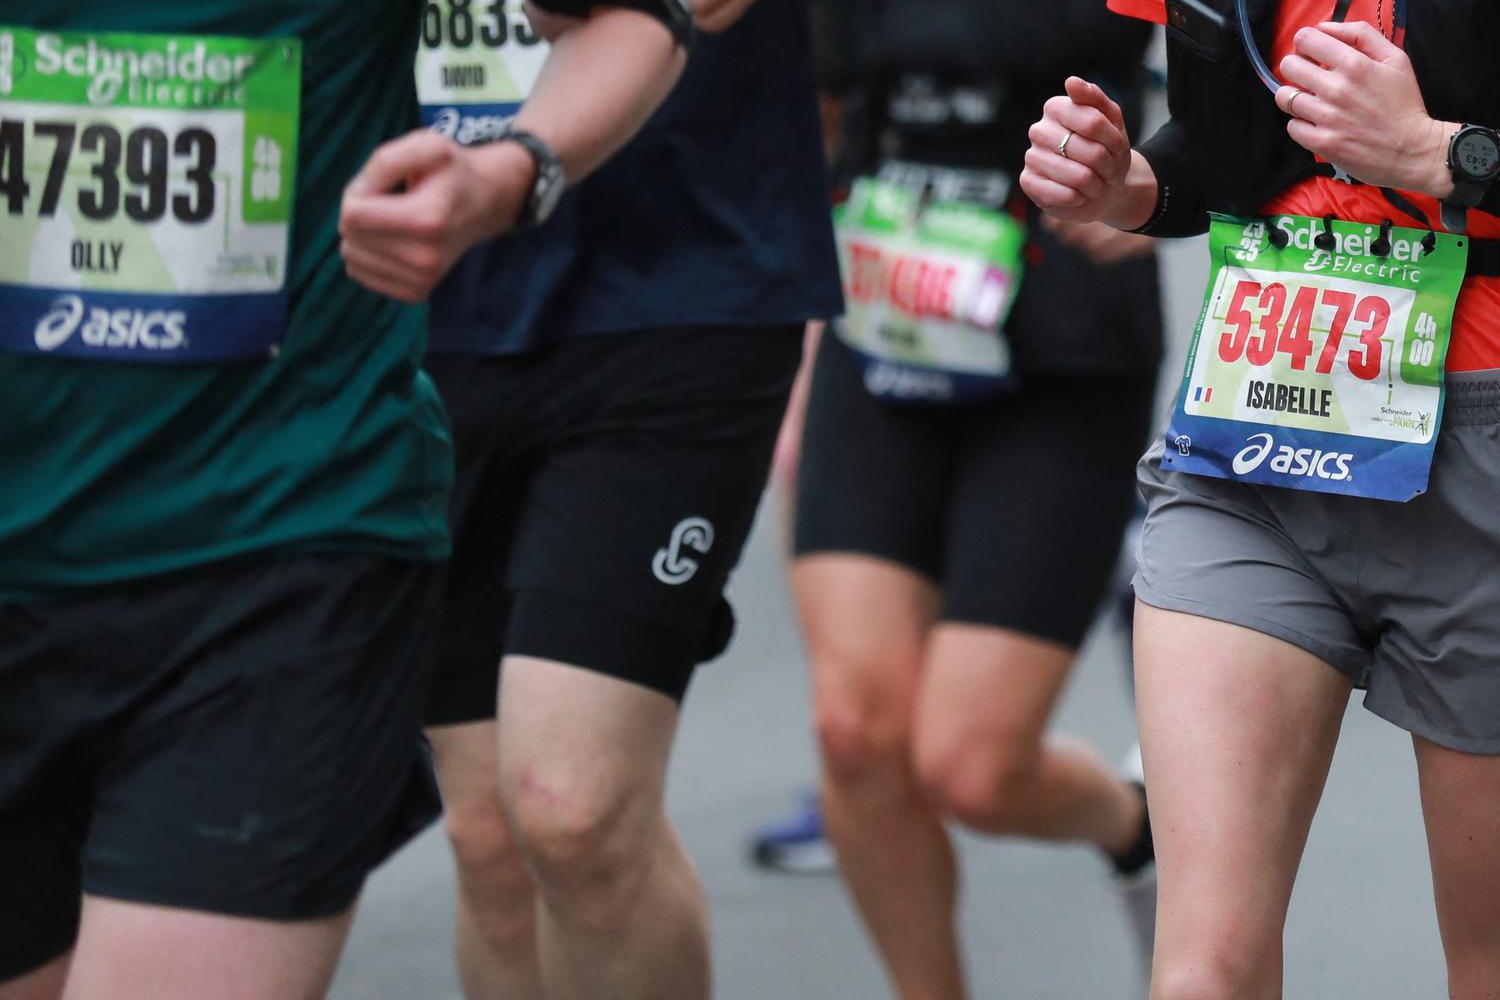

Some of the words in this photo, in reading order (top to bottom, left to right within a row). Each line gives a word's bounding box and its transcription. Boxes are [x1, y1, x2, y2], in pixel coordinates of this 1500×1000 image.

[34, 33, 254, 83] Schneider
[0, 117, 217, 224] 47393
[70, 239, 124, 273] OLLY
[1332, 255, 1421, 283] Electric
[81, 308, 187, 350] asics
[1218, 280, 1391, 381] 53473
[1413, 312, 1437, 340] 4h
[1408, 338, 1435, 367] 00
[1246, 380, 1333, 418] ISABELLE
[1381, 406, 1413, 417] Schneider
[1270, 446, 1354, 481] asics
